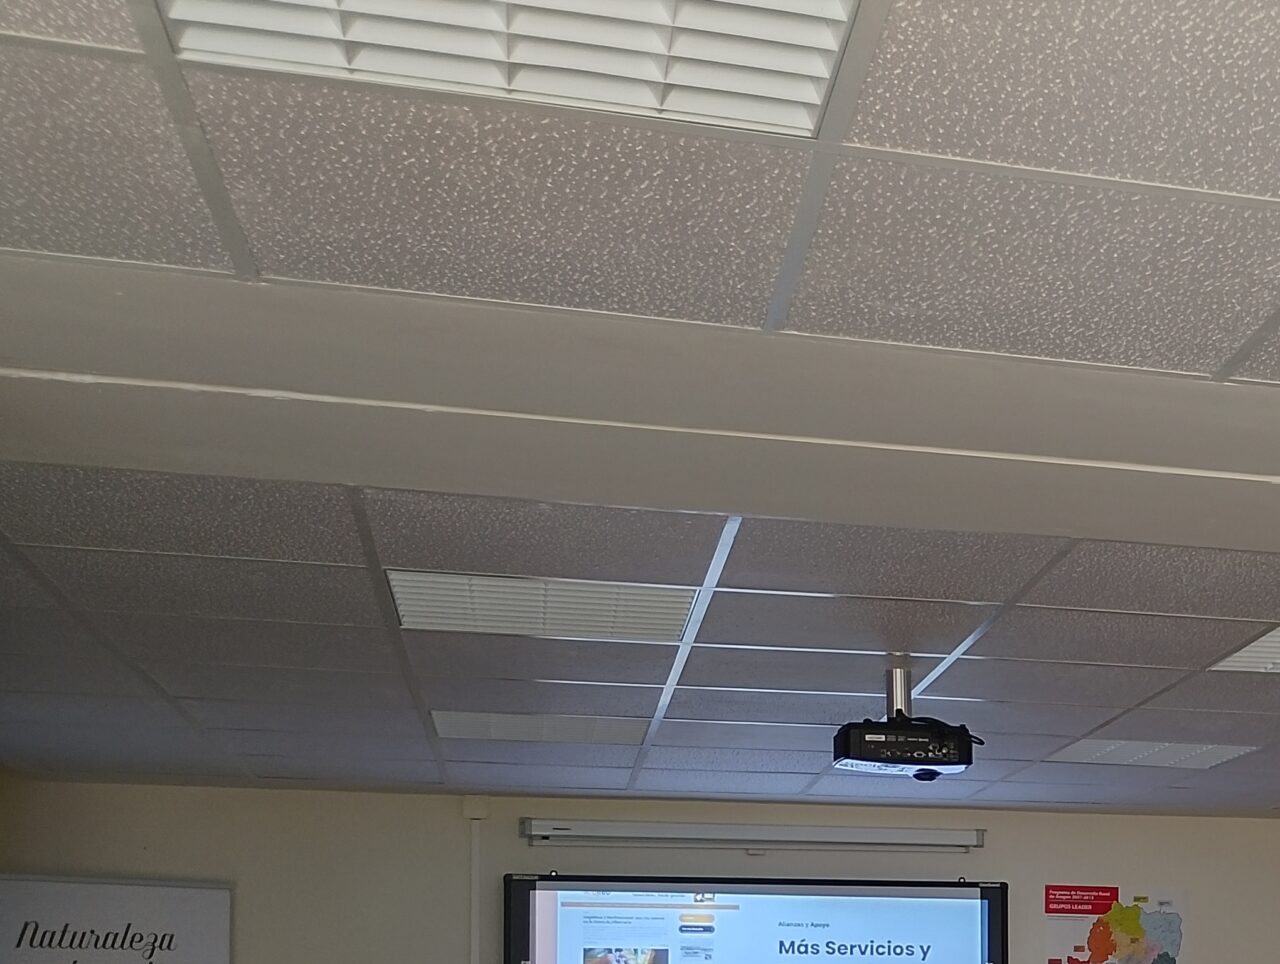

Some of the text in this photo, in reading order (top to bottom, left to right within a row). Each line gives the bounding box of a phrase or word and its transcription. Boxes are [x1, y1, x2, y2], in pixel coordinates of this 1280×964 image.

[16, 920, 177, 960] Naturaleza
[778, 938, 932, 962] Más Servicios y
